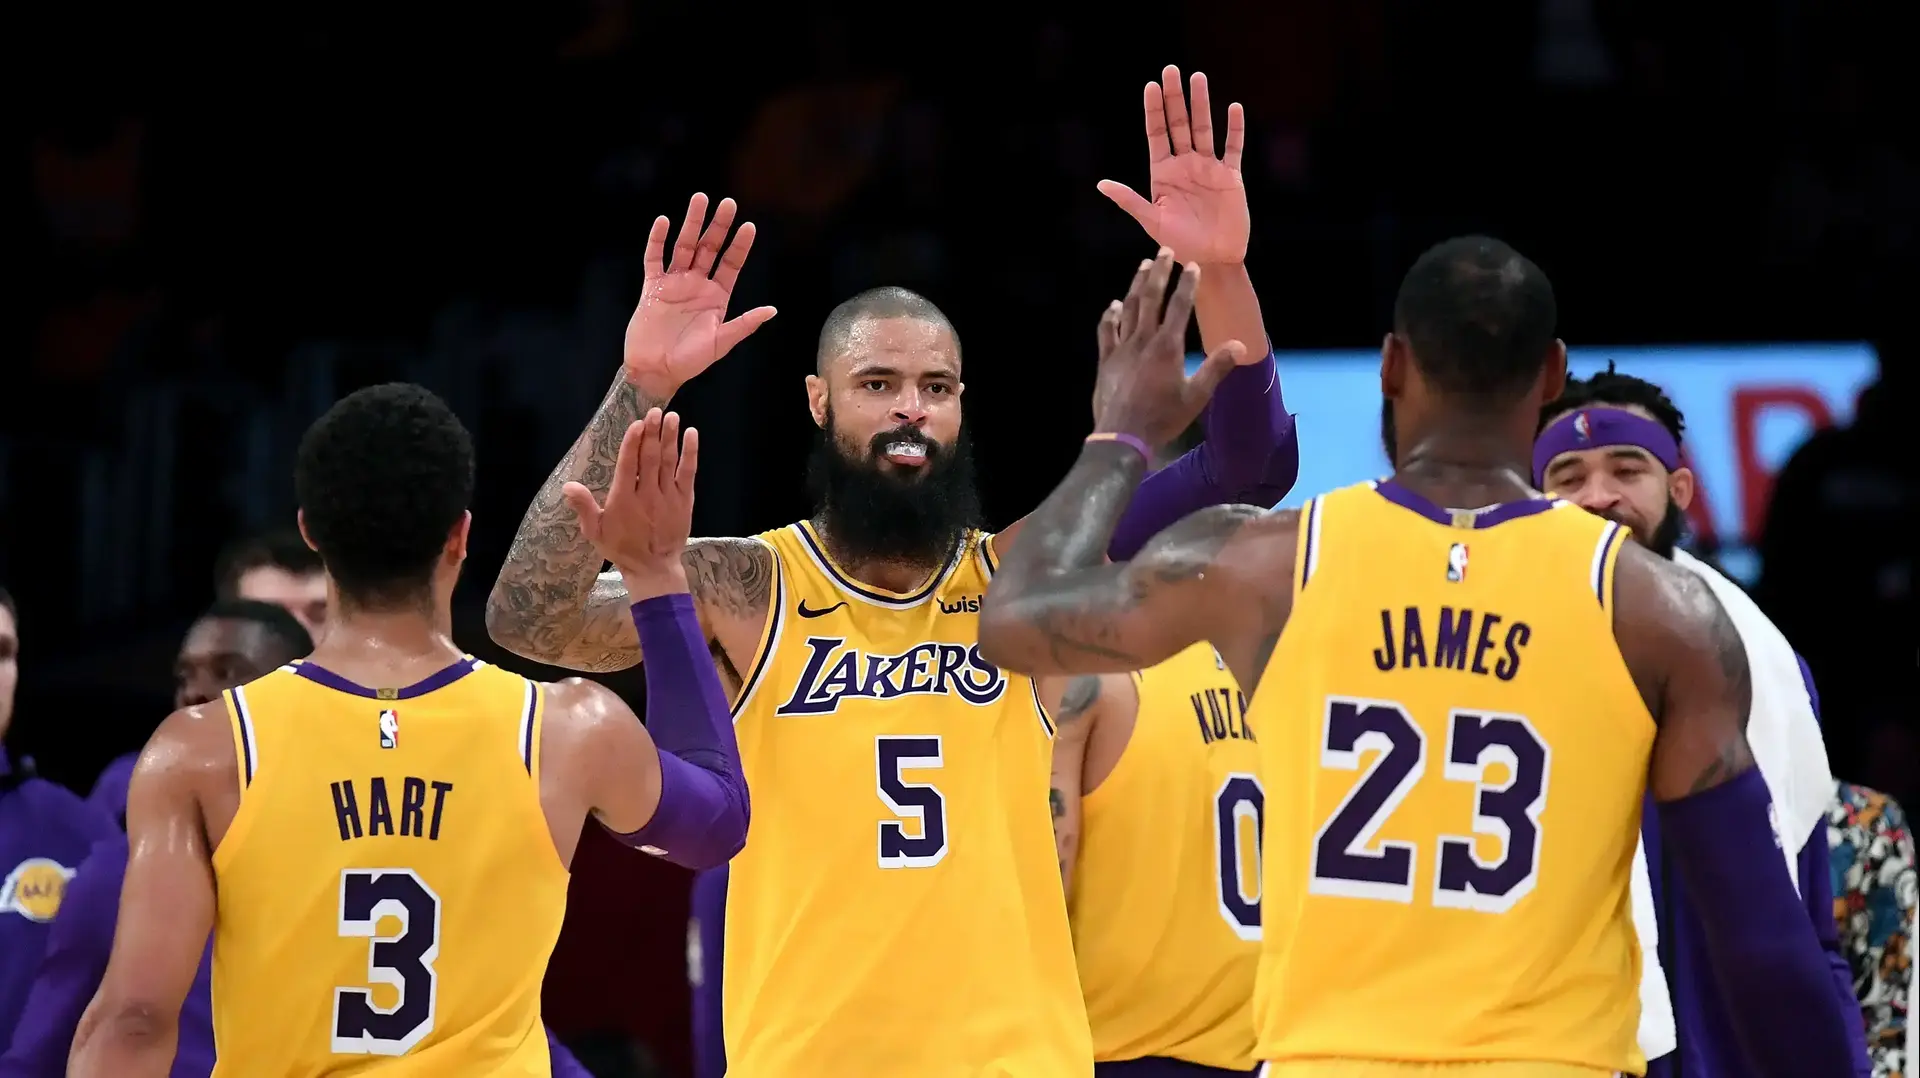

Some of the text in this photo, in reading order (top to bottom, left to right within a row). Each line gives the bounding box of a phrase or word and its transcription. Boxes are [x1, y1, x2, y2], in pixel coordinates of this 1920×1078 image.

[774, 635, 1008, 717] LAKERS
[1373, 606, 1531, 682] JAMES
[330, 776, 453, 841] HART
[875, 735, 949, 868] 5
[1213, 771, 1264, 941] 0
[1309, 694, 1552, 913] 23
[331, 867, 442, 1056] 3
